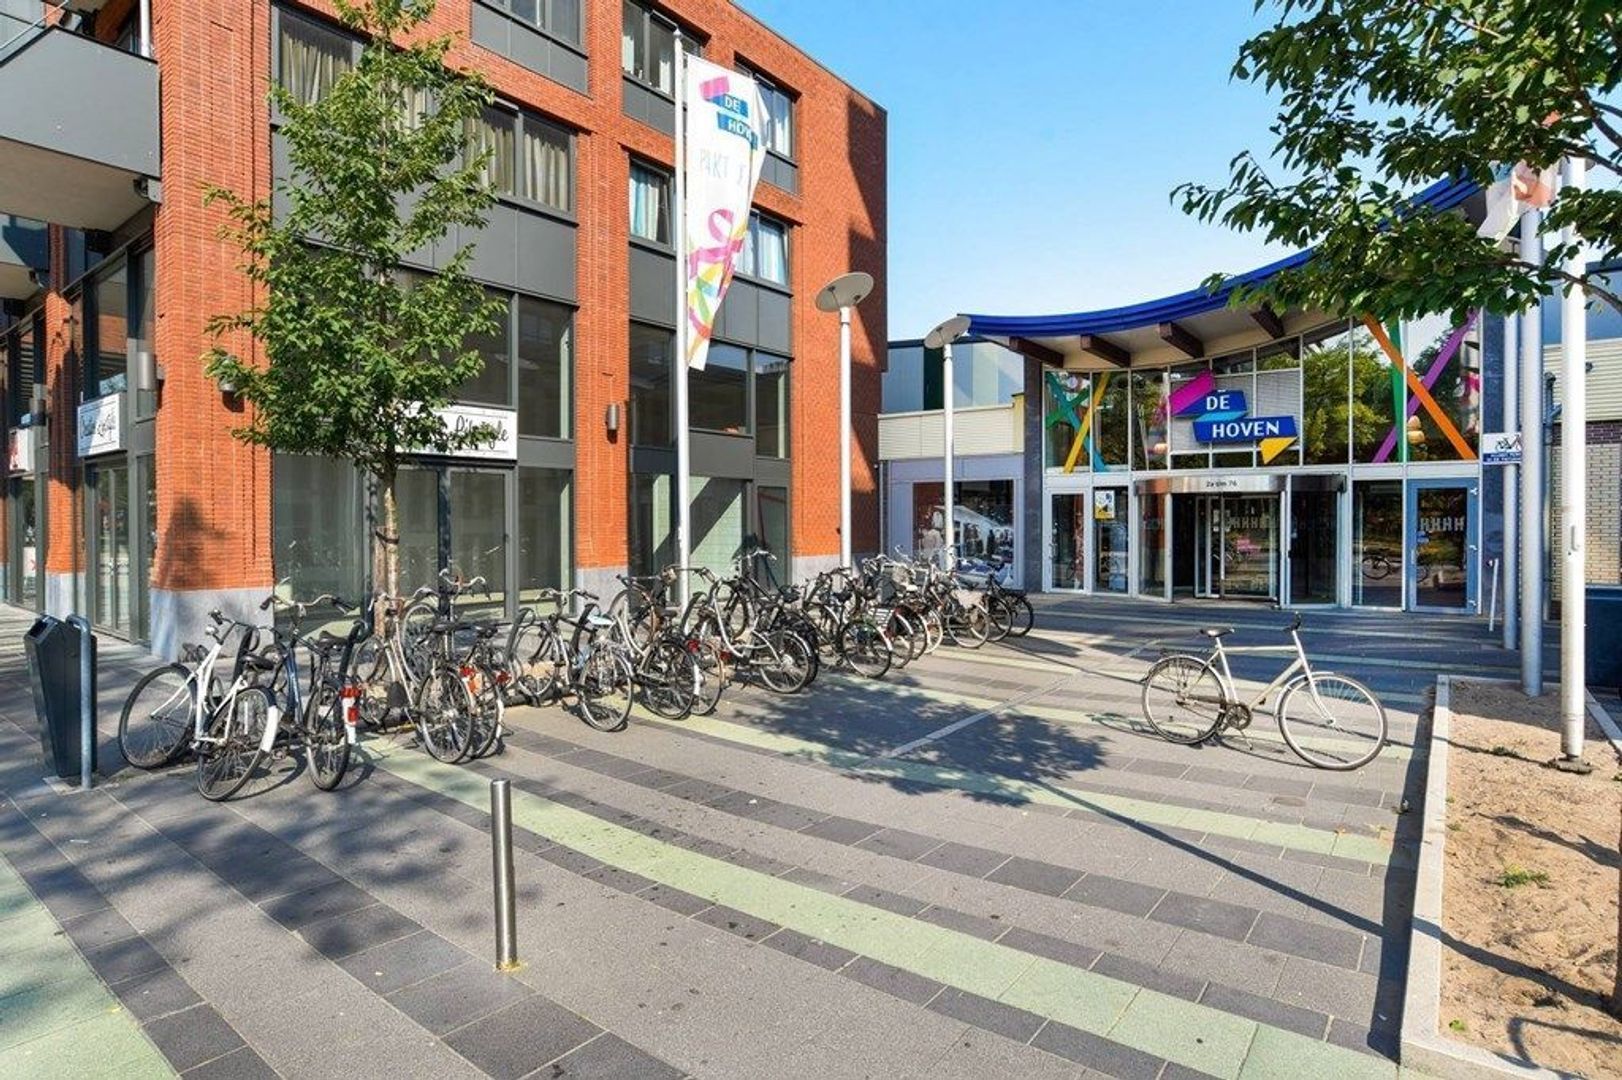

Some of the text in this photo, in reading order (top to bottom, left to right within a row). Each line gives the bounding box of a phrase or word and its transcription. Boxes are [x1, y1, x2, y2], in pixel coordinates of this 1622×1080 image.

[724, 96, 741, 113] DE
[1206, 394, 1231, 411] DE
[1212, 420, 1280, 438] HOVEN
